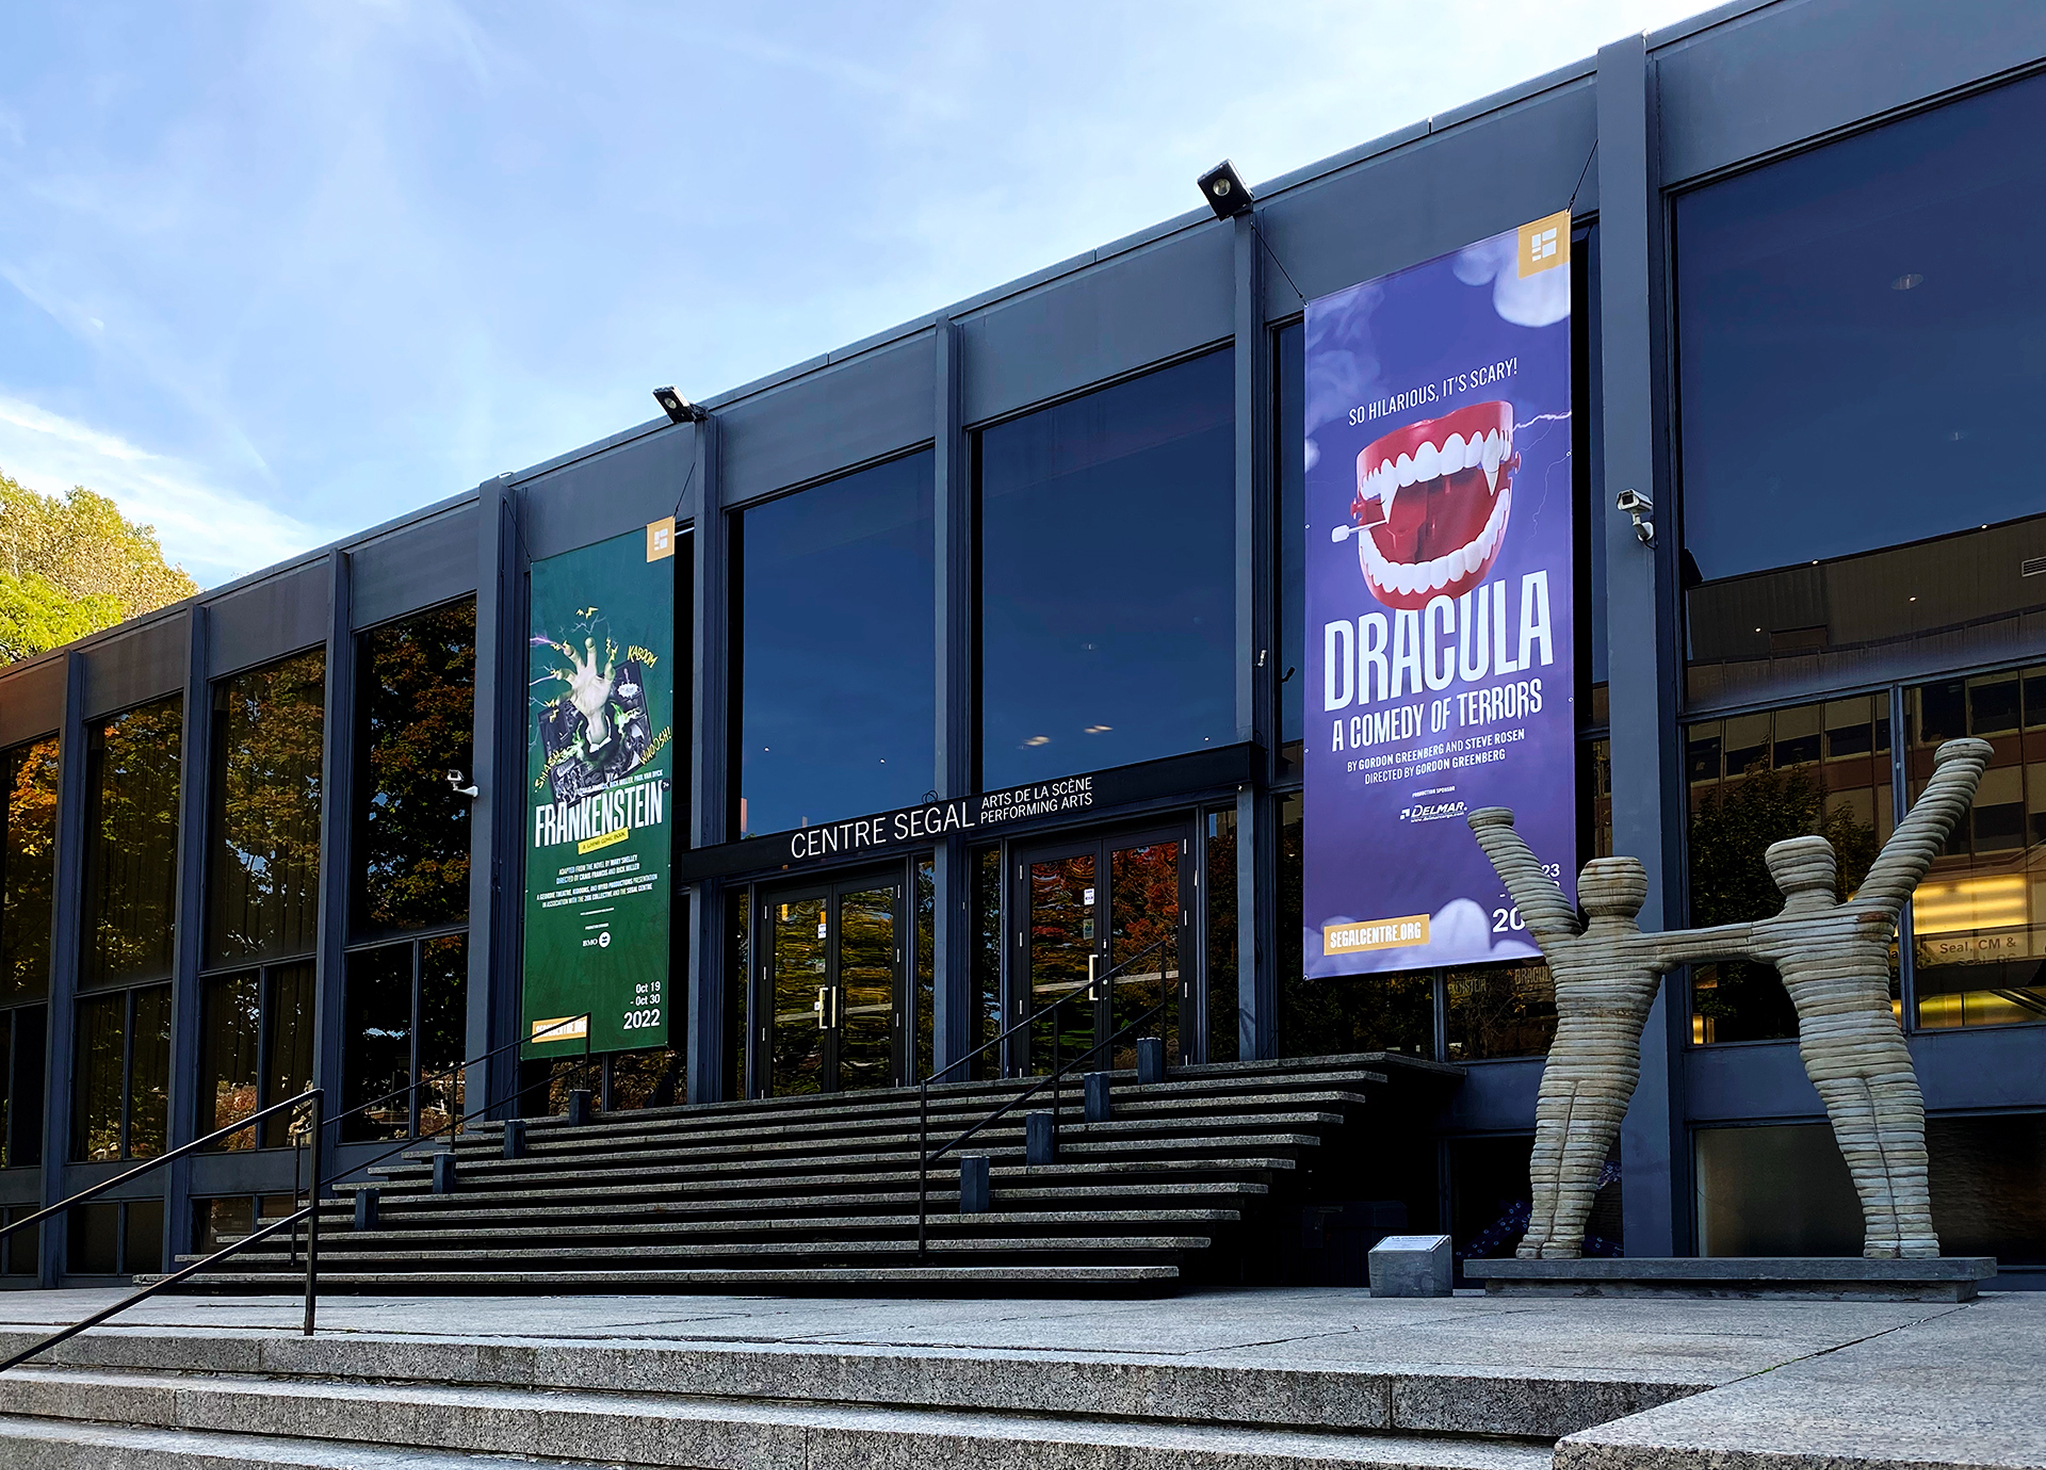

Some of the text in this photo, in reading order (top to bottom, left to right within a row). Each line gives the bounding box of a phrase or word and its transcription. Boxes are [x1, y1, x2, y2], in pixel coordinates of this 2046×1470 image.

[1349, 357, 1517, 426] SO HILARIOUS, IT'S SCARY!
[627, 645, 658, 668] KABOOM
[1324, 570, 1554, 712] DRACULA
[1332, 678, 1542, 752] A COMEDY OF TERRORS
[1347, 728, 1524, 772] BY GORDON GREENBERG AND STEVE ROSEN
[1365, 749, 1505, 785] DIRECTED BY GORDON GREENBERG
[980, 792, 1093, 824] PERFORMING ARTS
[981, 776, 1092, 809] ARTS DE LA SCÈNE
[535, 780, 662, 847] FRANKENSTEIN
[791, 801, 975, 858] CENTRE SEGAL
[1330, 922, 1421, 949] SEGALCENTRE.ORG
[1492, 907, 1526, 932] 20
[1978, 939, 2000, 950] CM
[2006, 937, 2016, 948] &
[635, 981, 661, 994] Oct 19
[635, 995, 648, 1006] Oct
[650, 993, 661, 1004] 30
[623, 1008, 661, 1030] 2022
